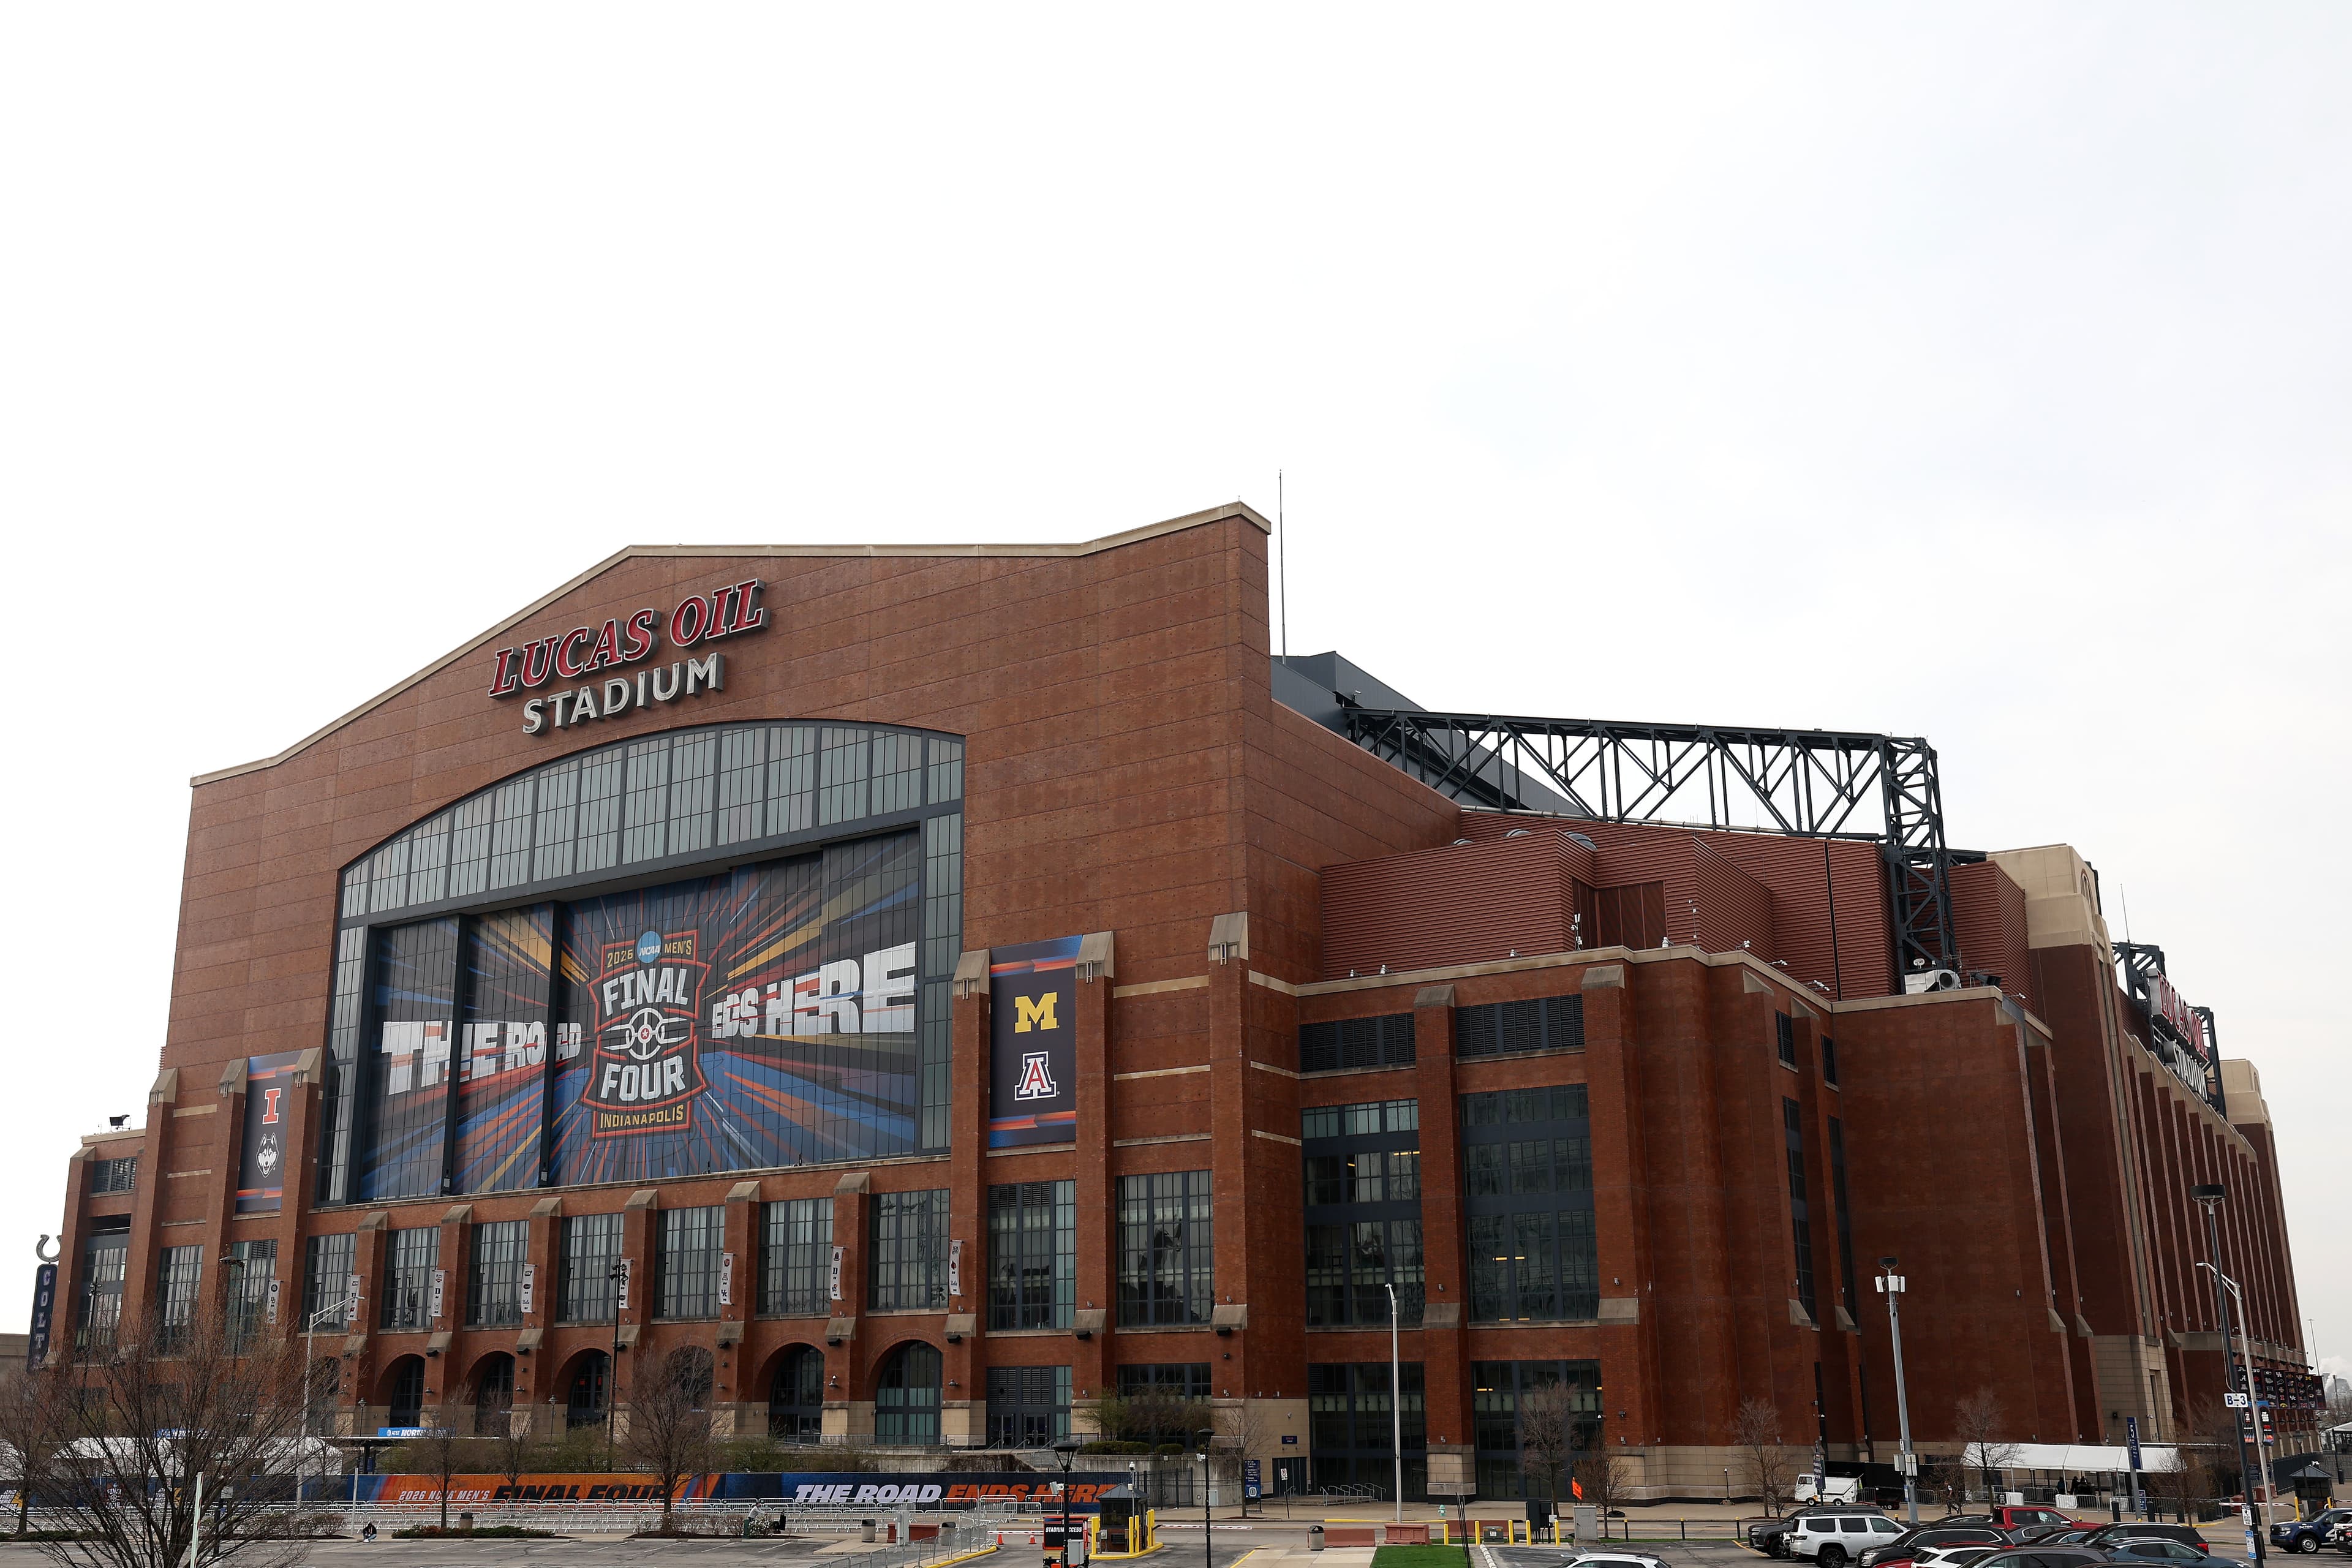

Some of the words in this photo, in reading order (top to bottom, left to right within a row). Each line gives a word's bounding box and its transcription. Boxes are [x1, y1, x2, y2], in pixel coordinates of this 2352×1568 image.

[488, 608, 660, 699] LUCAS
[670, 578, 770, 649] OIL
[522, 651, 724, 736] STADIUM
[608, 949, 633, 968] 2026
[639, 945, 660, 956] NCAA
[665, 940, 692, 955] MEN'S
[603, 967, 688, 1017] FINAL
[765, 941, 916, 1035] HERE
[1015, 992, 1057, 1033] M
[381, 1020, 498, 1096] THE
[600, 1055, 686, 1101] FOUR
[1014, 1051, 1057, 1101] A
[600, 1104, 684, 1129] INDIANAPOLIS
[2130, 1424, 2135, 1438] 5
[399, 1490, 427, 1500] 2026
[428, 1490, 454, 1500] NCA
[456, 1490, 491, 1500] MEN'S
[492, 1485, 580, 1504] FINAL
[794, 1484, 854, 1503] THE
[854, 1484, 941, 1503] ROAD
[946, 1484, 1030, 1503] ENDS
